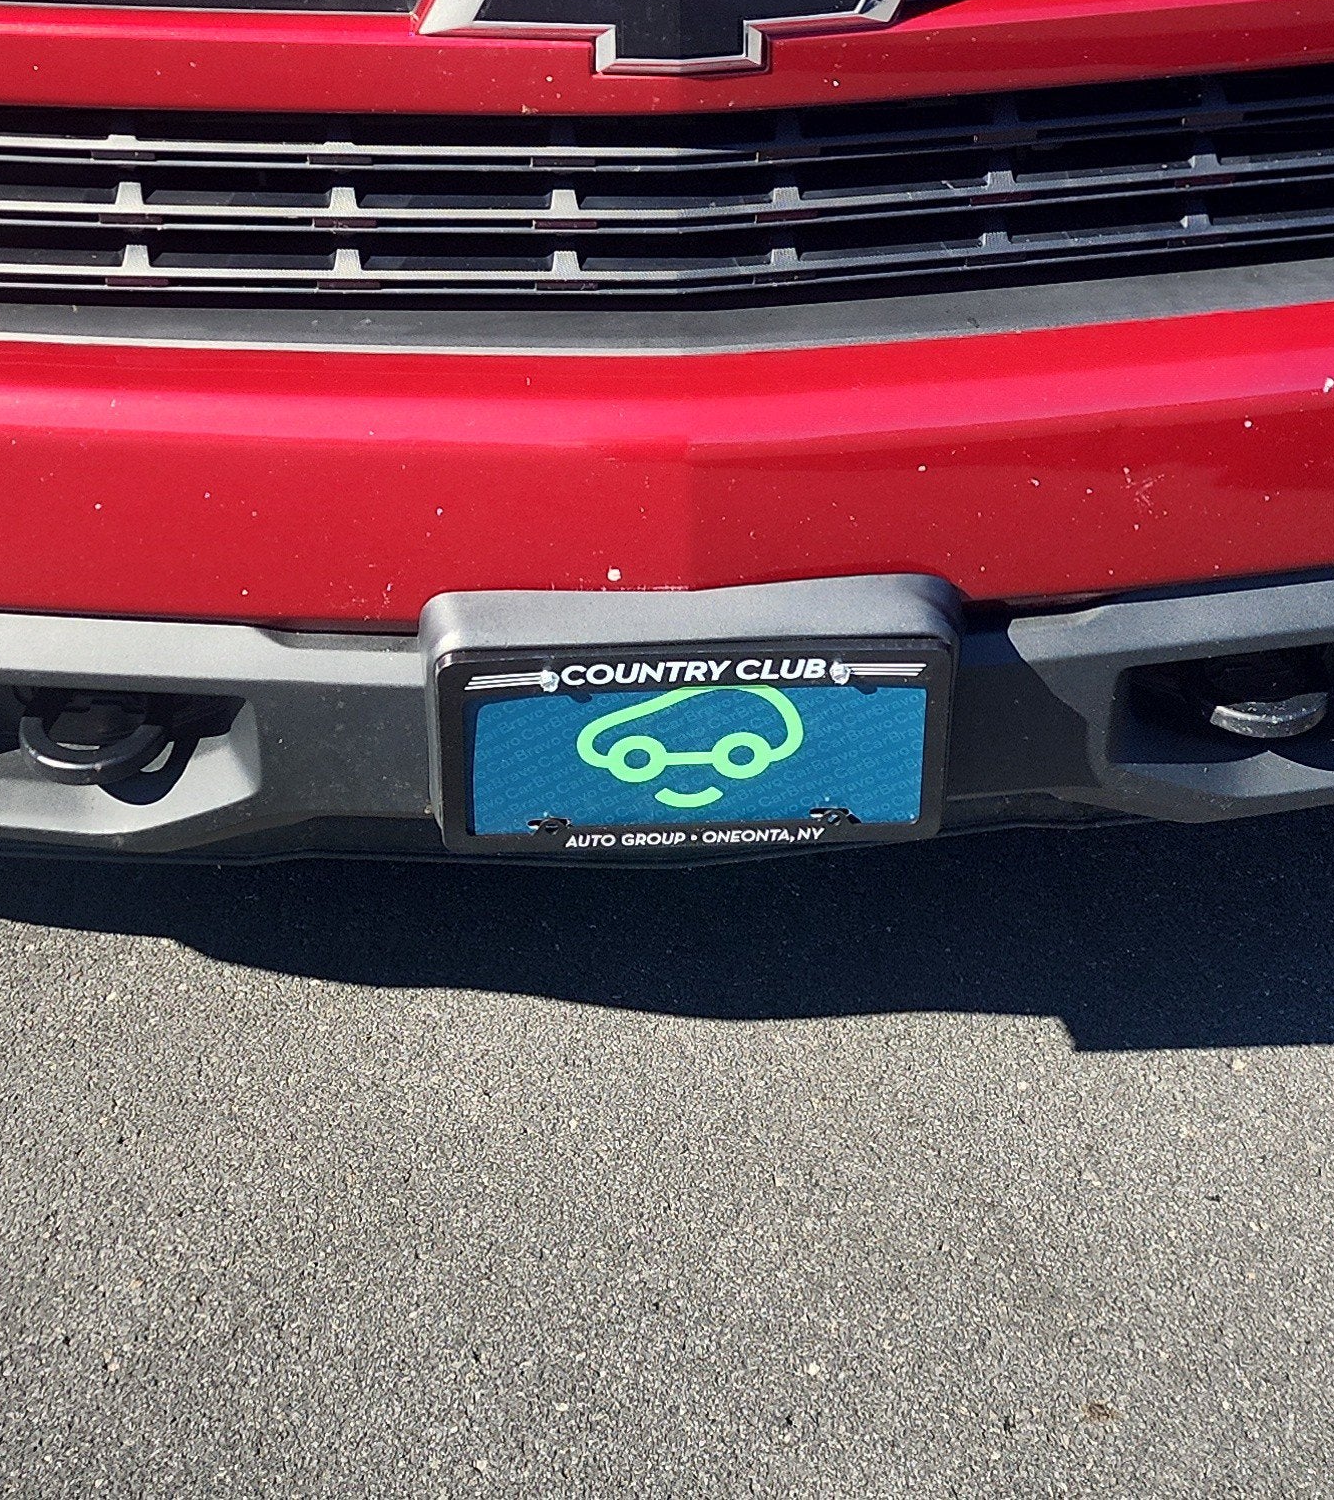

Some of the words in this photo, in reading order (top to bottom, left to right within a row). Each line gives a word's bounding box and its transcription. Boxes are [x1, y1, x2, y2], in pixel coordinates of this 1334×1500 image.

[561, 661, 731, 686] COUNTRY
[735, 658, 827, 681] CLUB
[565, 833, 616, 848] AUTO
[621, 832, 686, 847] GROUP
